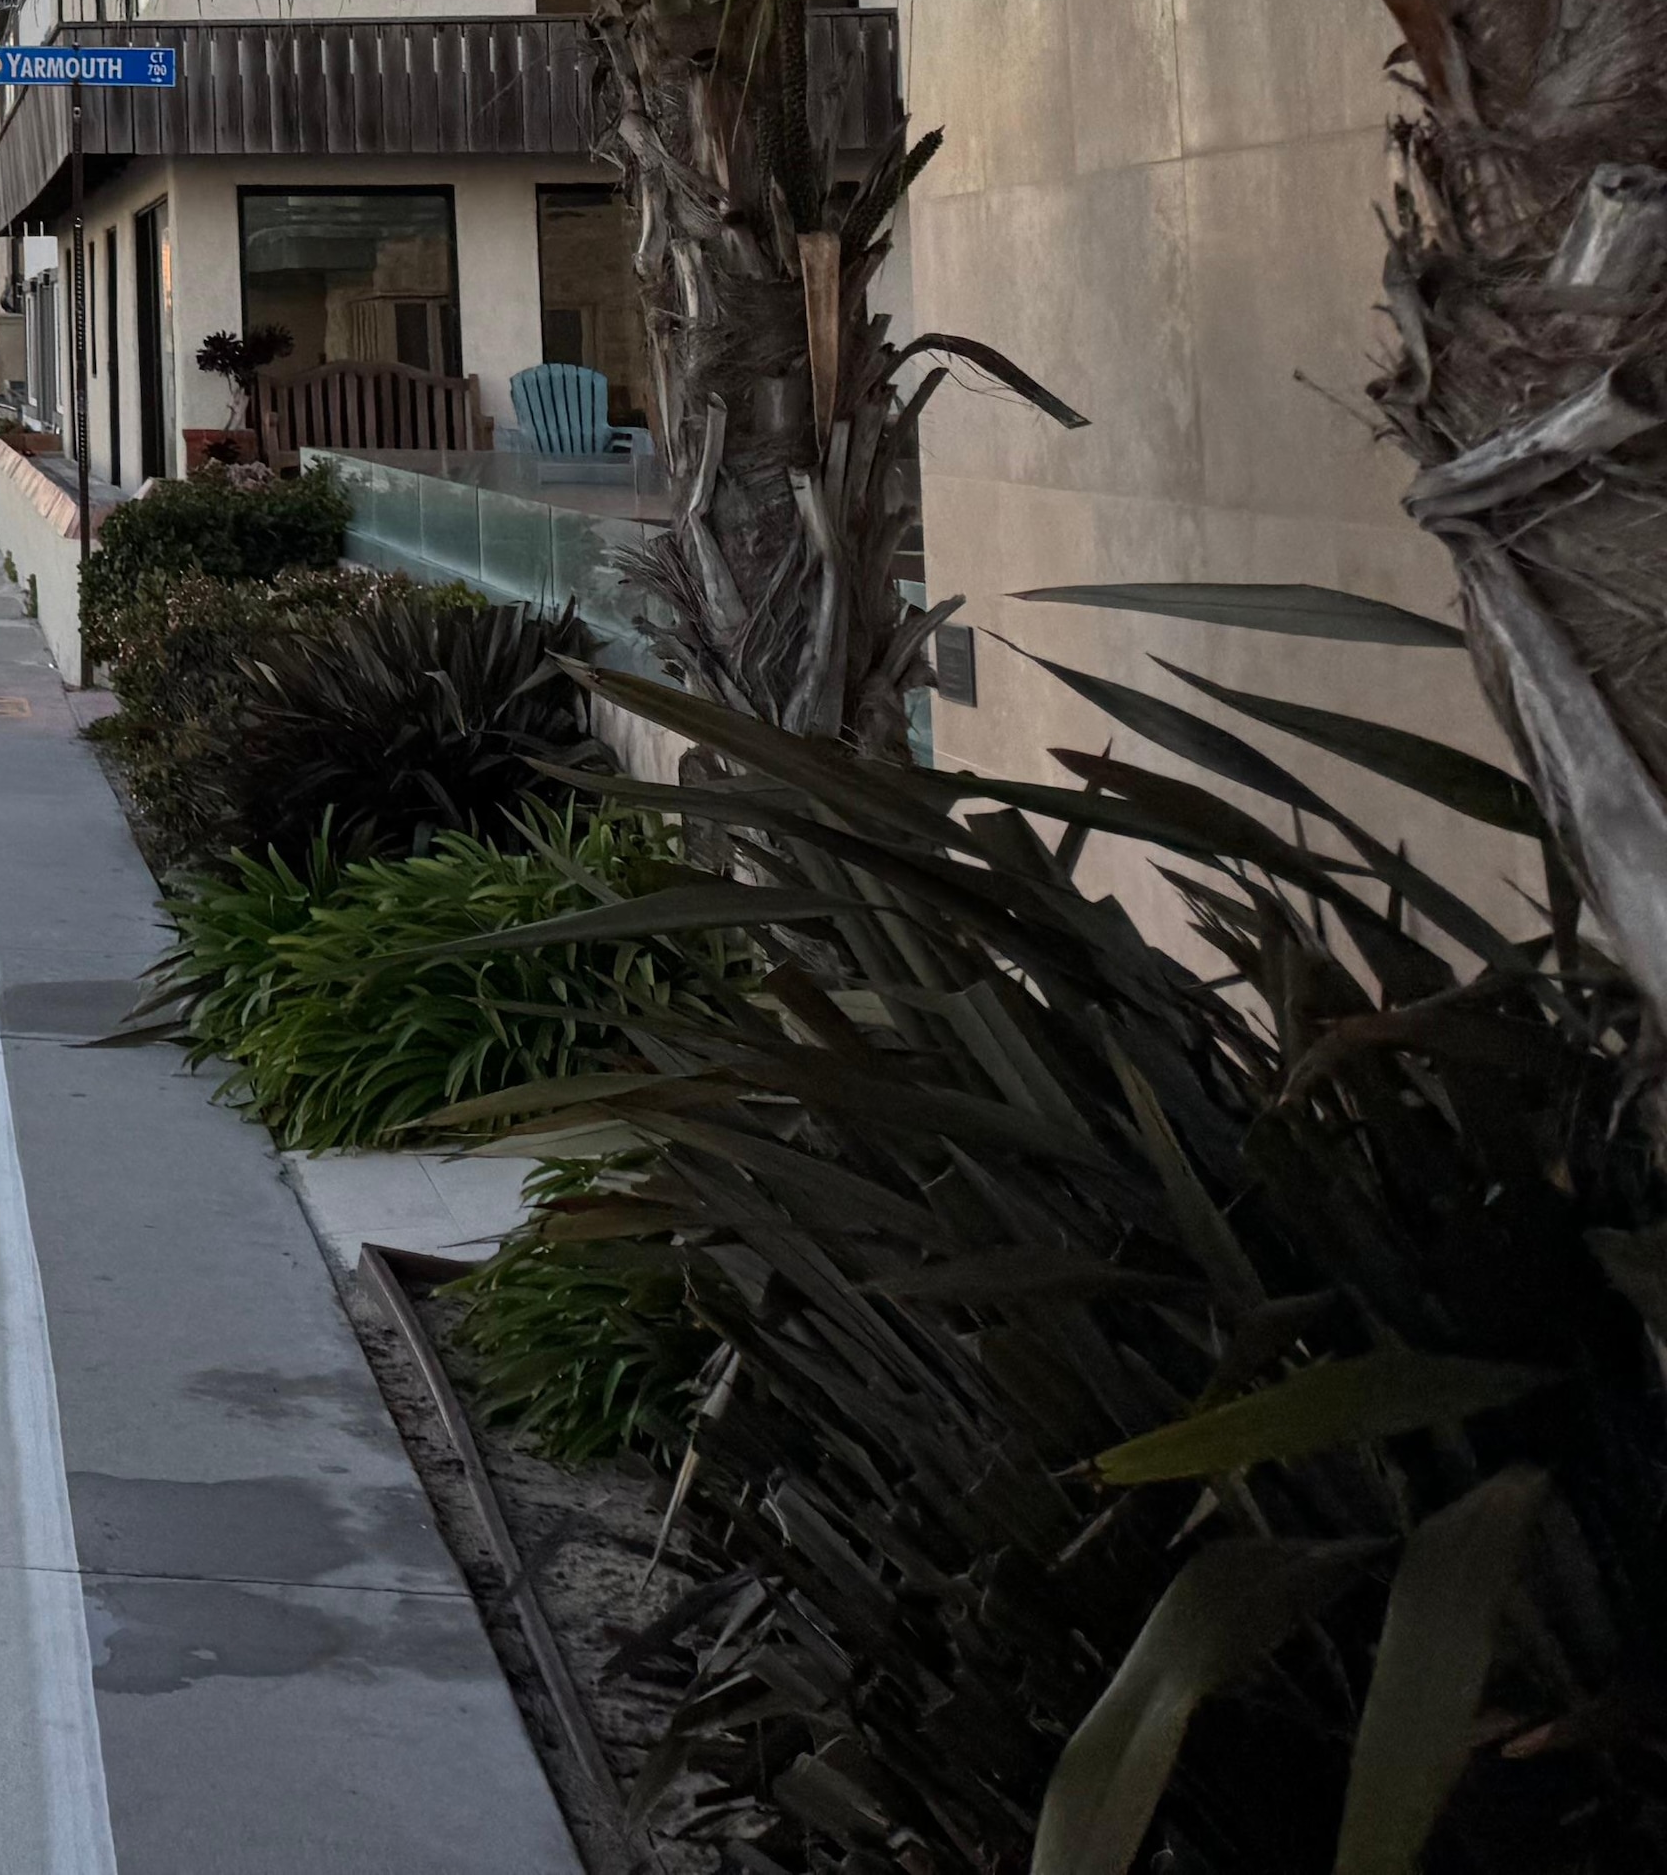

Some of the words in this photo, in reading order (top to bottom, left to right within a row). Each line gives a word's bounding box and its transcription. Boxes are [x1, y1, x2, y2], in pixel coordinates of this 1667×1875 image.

[150, 51, 165, 63] CT
[6, 52, 122, 80] YARMOUTH
[147, 63, 167, 76] 700
